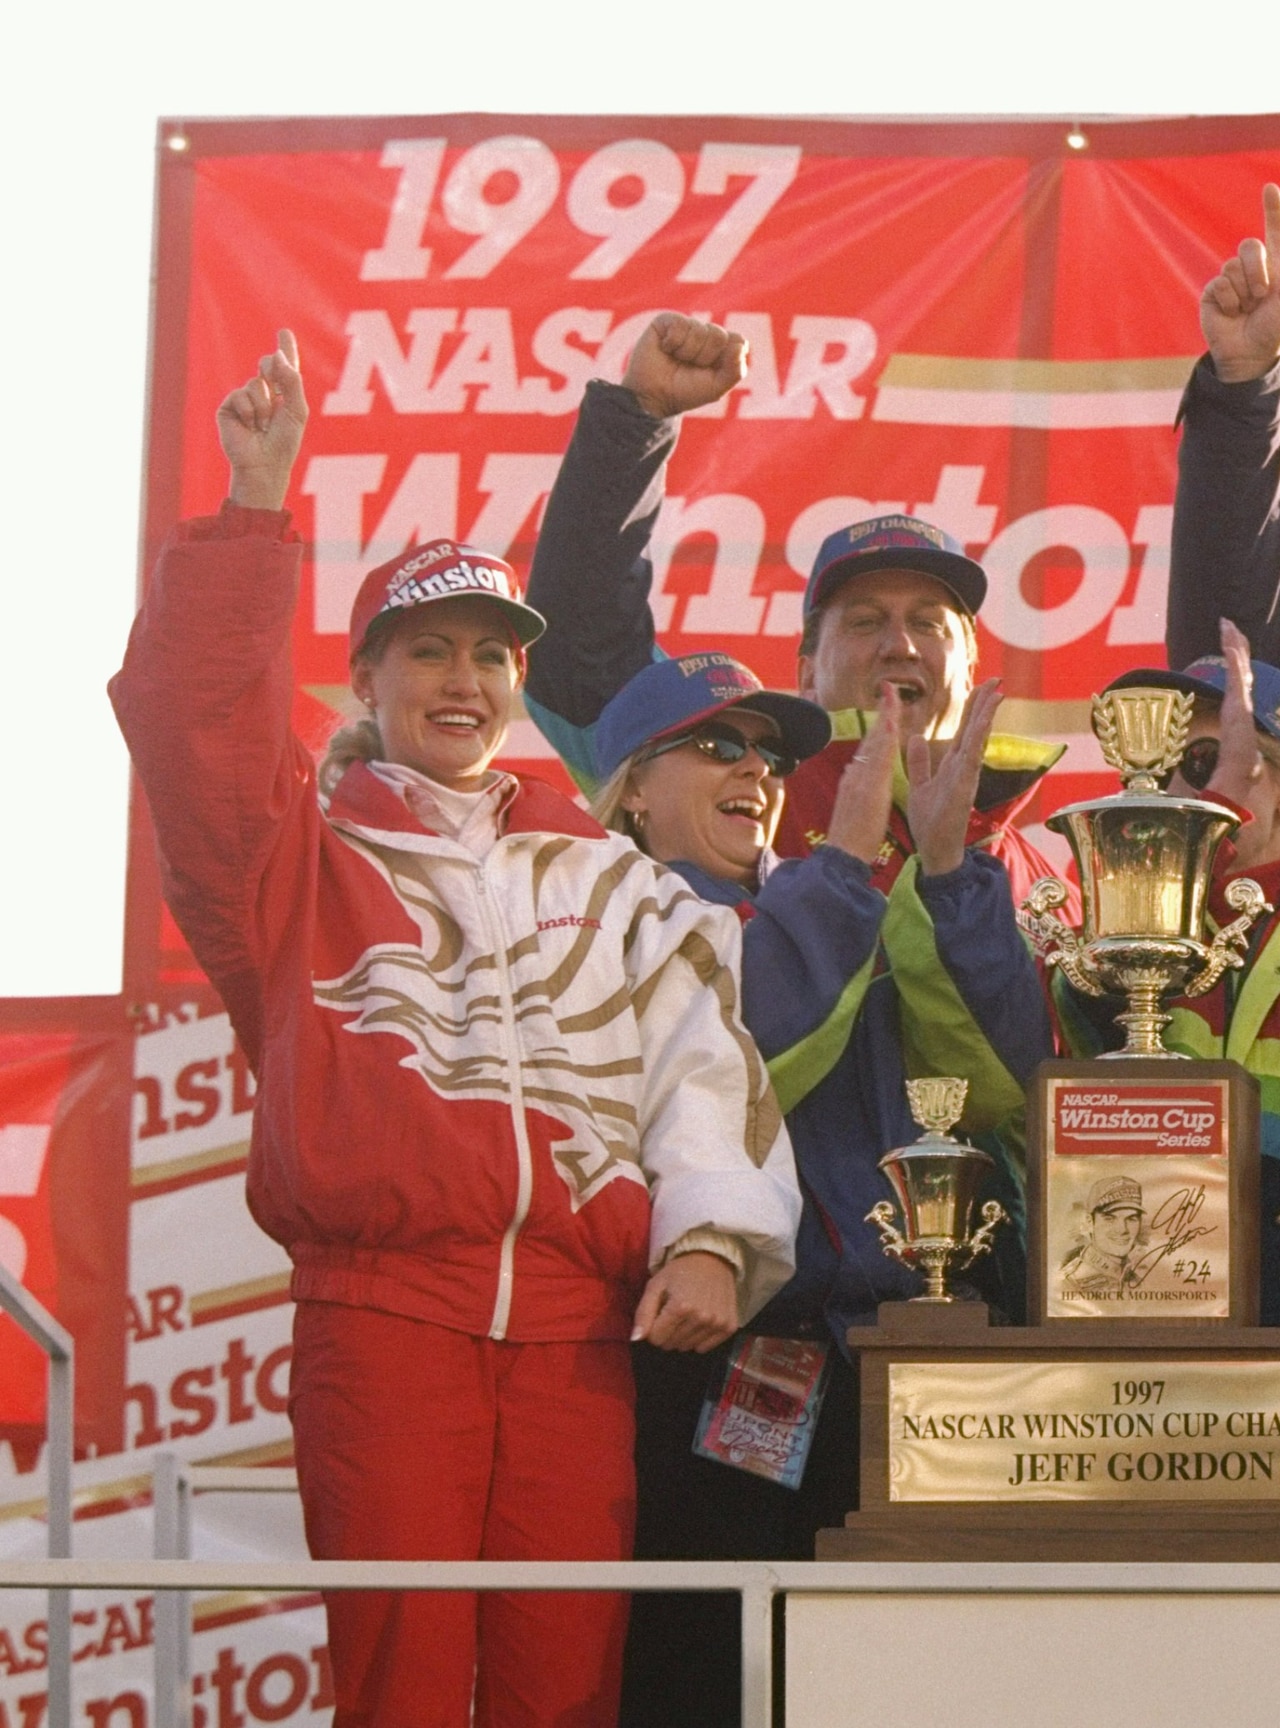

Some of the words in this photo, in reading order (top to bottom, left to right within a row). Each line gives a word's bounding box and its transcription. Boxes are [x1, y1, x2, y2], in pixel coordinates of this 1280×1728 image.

[359, 136, 802, 284] 1997
[301, 452, 1174, 650] Wnsto
[386, 543, 454, 593] NASCAR
[381, 560, 511, 612] Winston
[536, 914, 603, 932] inston
[1061, 1093, 1119, 1107] NASCAR
[1060, 1109, 1159, 1130] Winston
[1163, 1109, 1216, 1133] Cup
[1156, 1132, 1212, 1148] Series
[1173, 1259, 1212, 1284] #24
[1061, 1290, 1124, 1302] HENDRICK
[1128, 1290, 1218, 1302] MOTORSPORTS
[1112, 1380, 1166, 1406] 1997
[902, 1414, 1016, 1440] NASCAR
[1025, 1412, 1155, 1439] WINSTON
[1163, 1412, 1220, 1438] CUP
[1008, 1452, 1097, 1486] JEFF
[1107, 1450, 1274, 1482] GORDON
